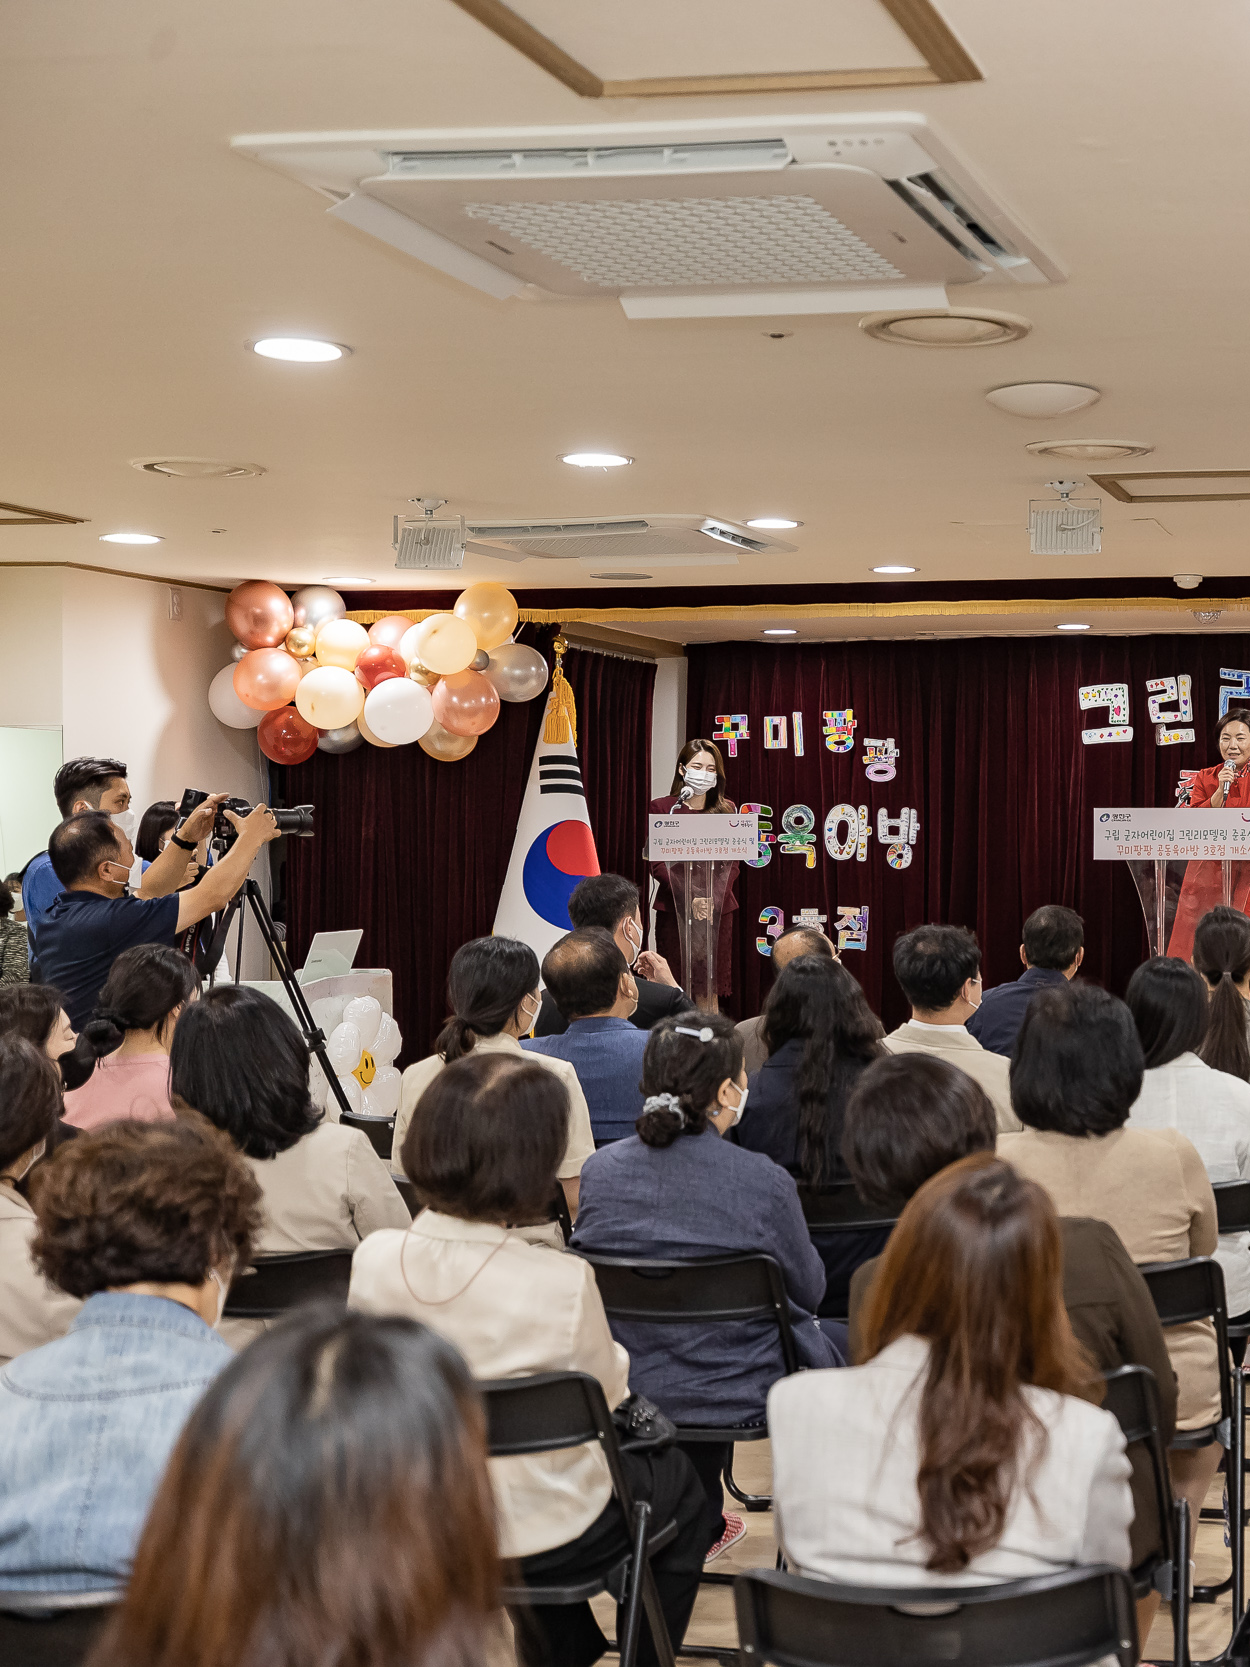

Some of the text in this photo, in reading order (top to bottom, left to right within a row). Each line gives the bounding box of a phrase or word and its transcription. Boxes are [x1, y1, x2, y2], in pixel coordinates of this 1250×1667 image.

[713, 708, 900, 782] 꾸미팡팡
[1104, 830, 1120, 841] 구립
[1124, 830, 1175, 841] 군자어린이집
[1179, 830, 1228, 841] 그린리모델링
[1116, 845, 1153, 856] 꾸미팡팡
[1156, 845, 1200, 856] 공동육아방
[1203, 845, 1226, 856] 3호점
